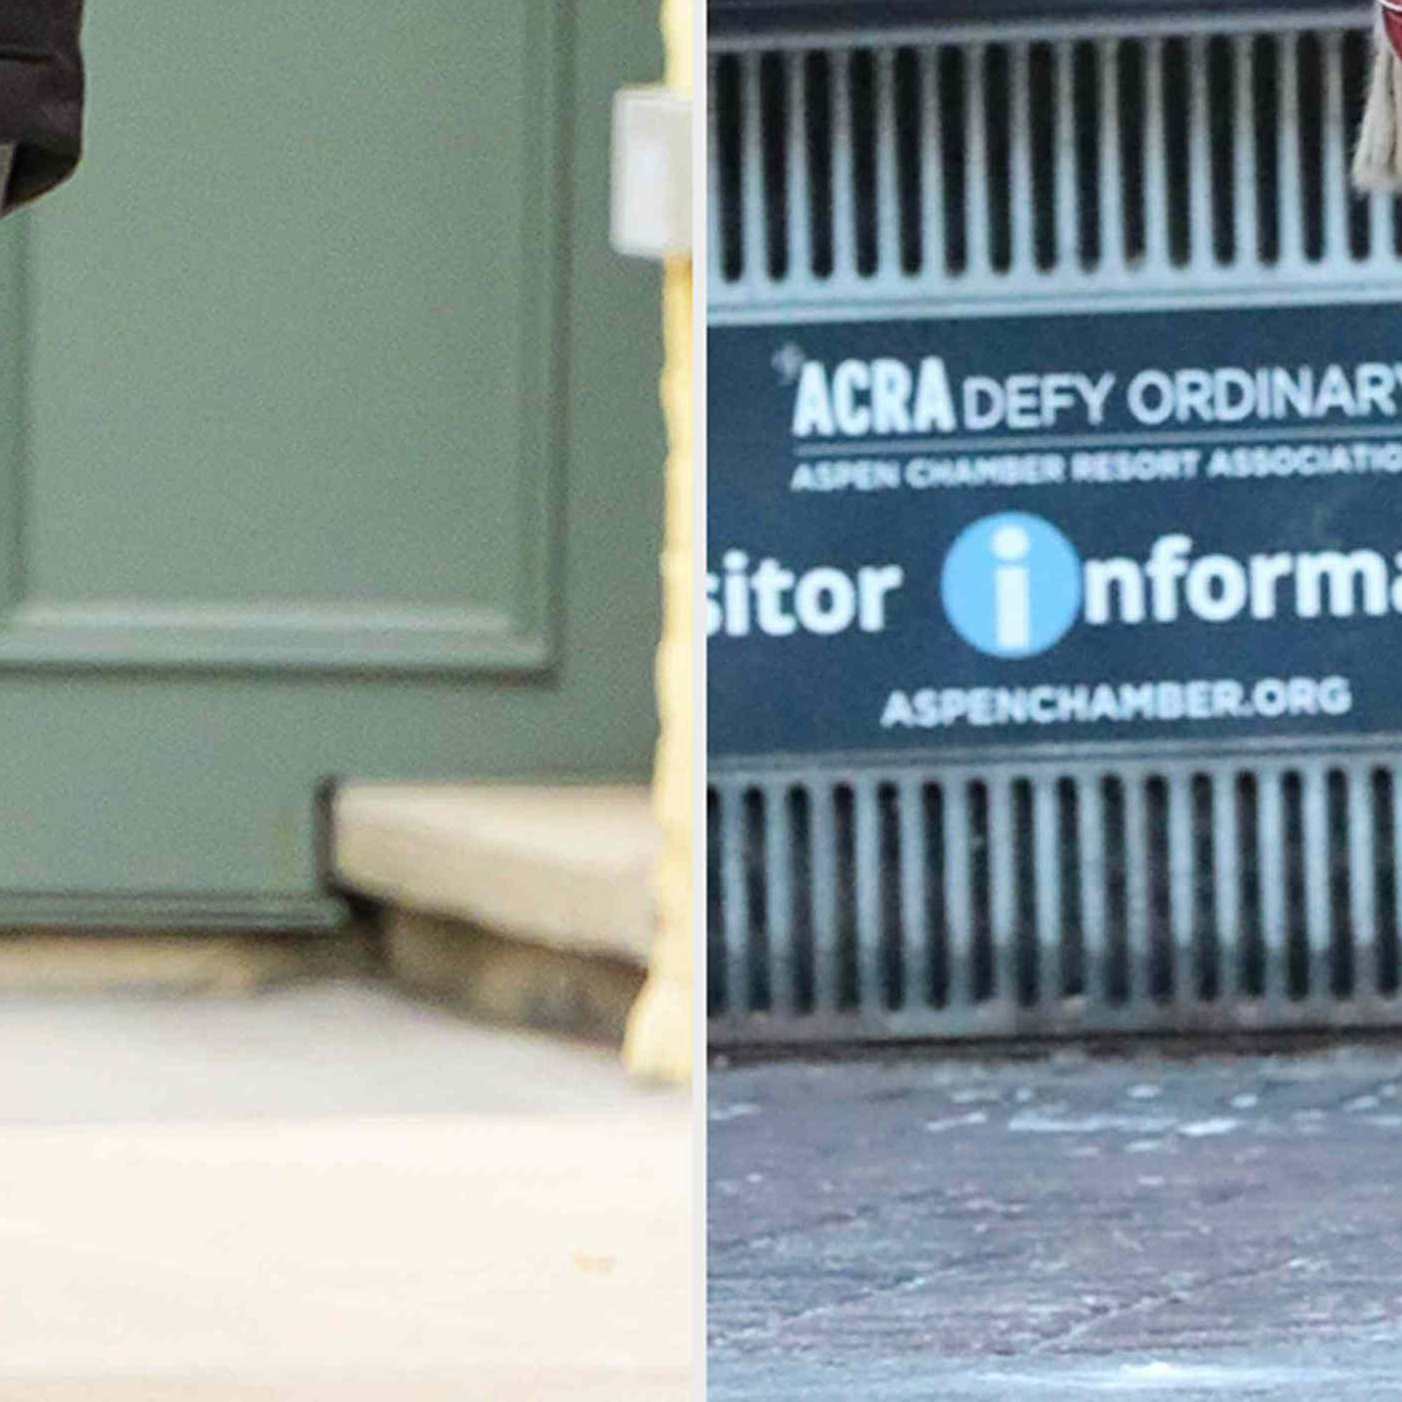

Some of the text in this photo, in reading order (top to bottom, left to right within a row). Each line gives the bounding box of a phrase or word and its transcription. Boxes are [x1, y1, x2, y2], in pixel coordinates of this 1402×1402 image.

[792, 355, 956, 437] ACRA
[962, 372, 1116, 430] DEFY
[791, 460, 900, 492] ASPEN
[904, 455, 1066, 490] CHAMBER
[1071, 448, 1200, 484] RESORT
[880, 676, 1353, 729] ASPENCHAMBER.ORG
